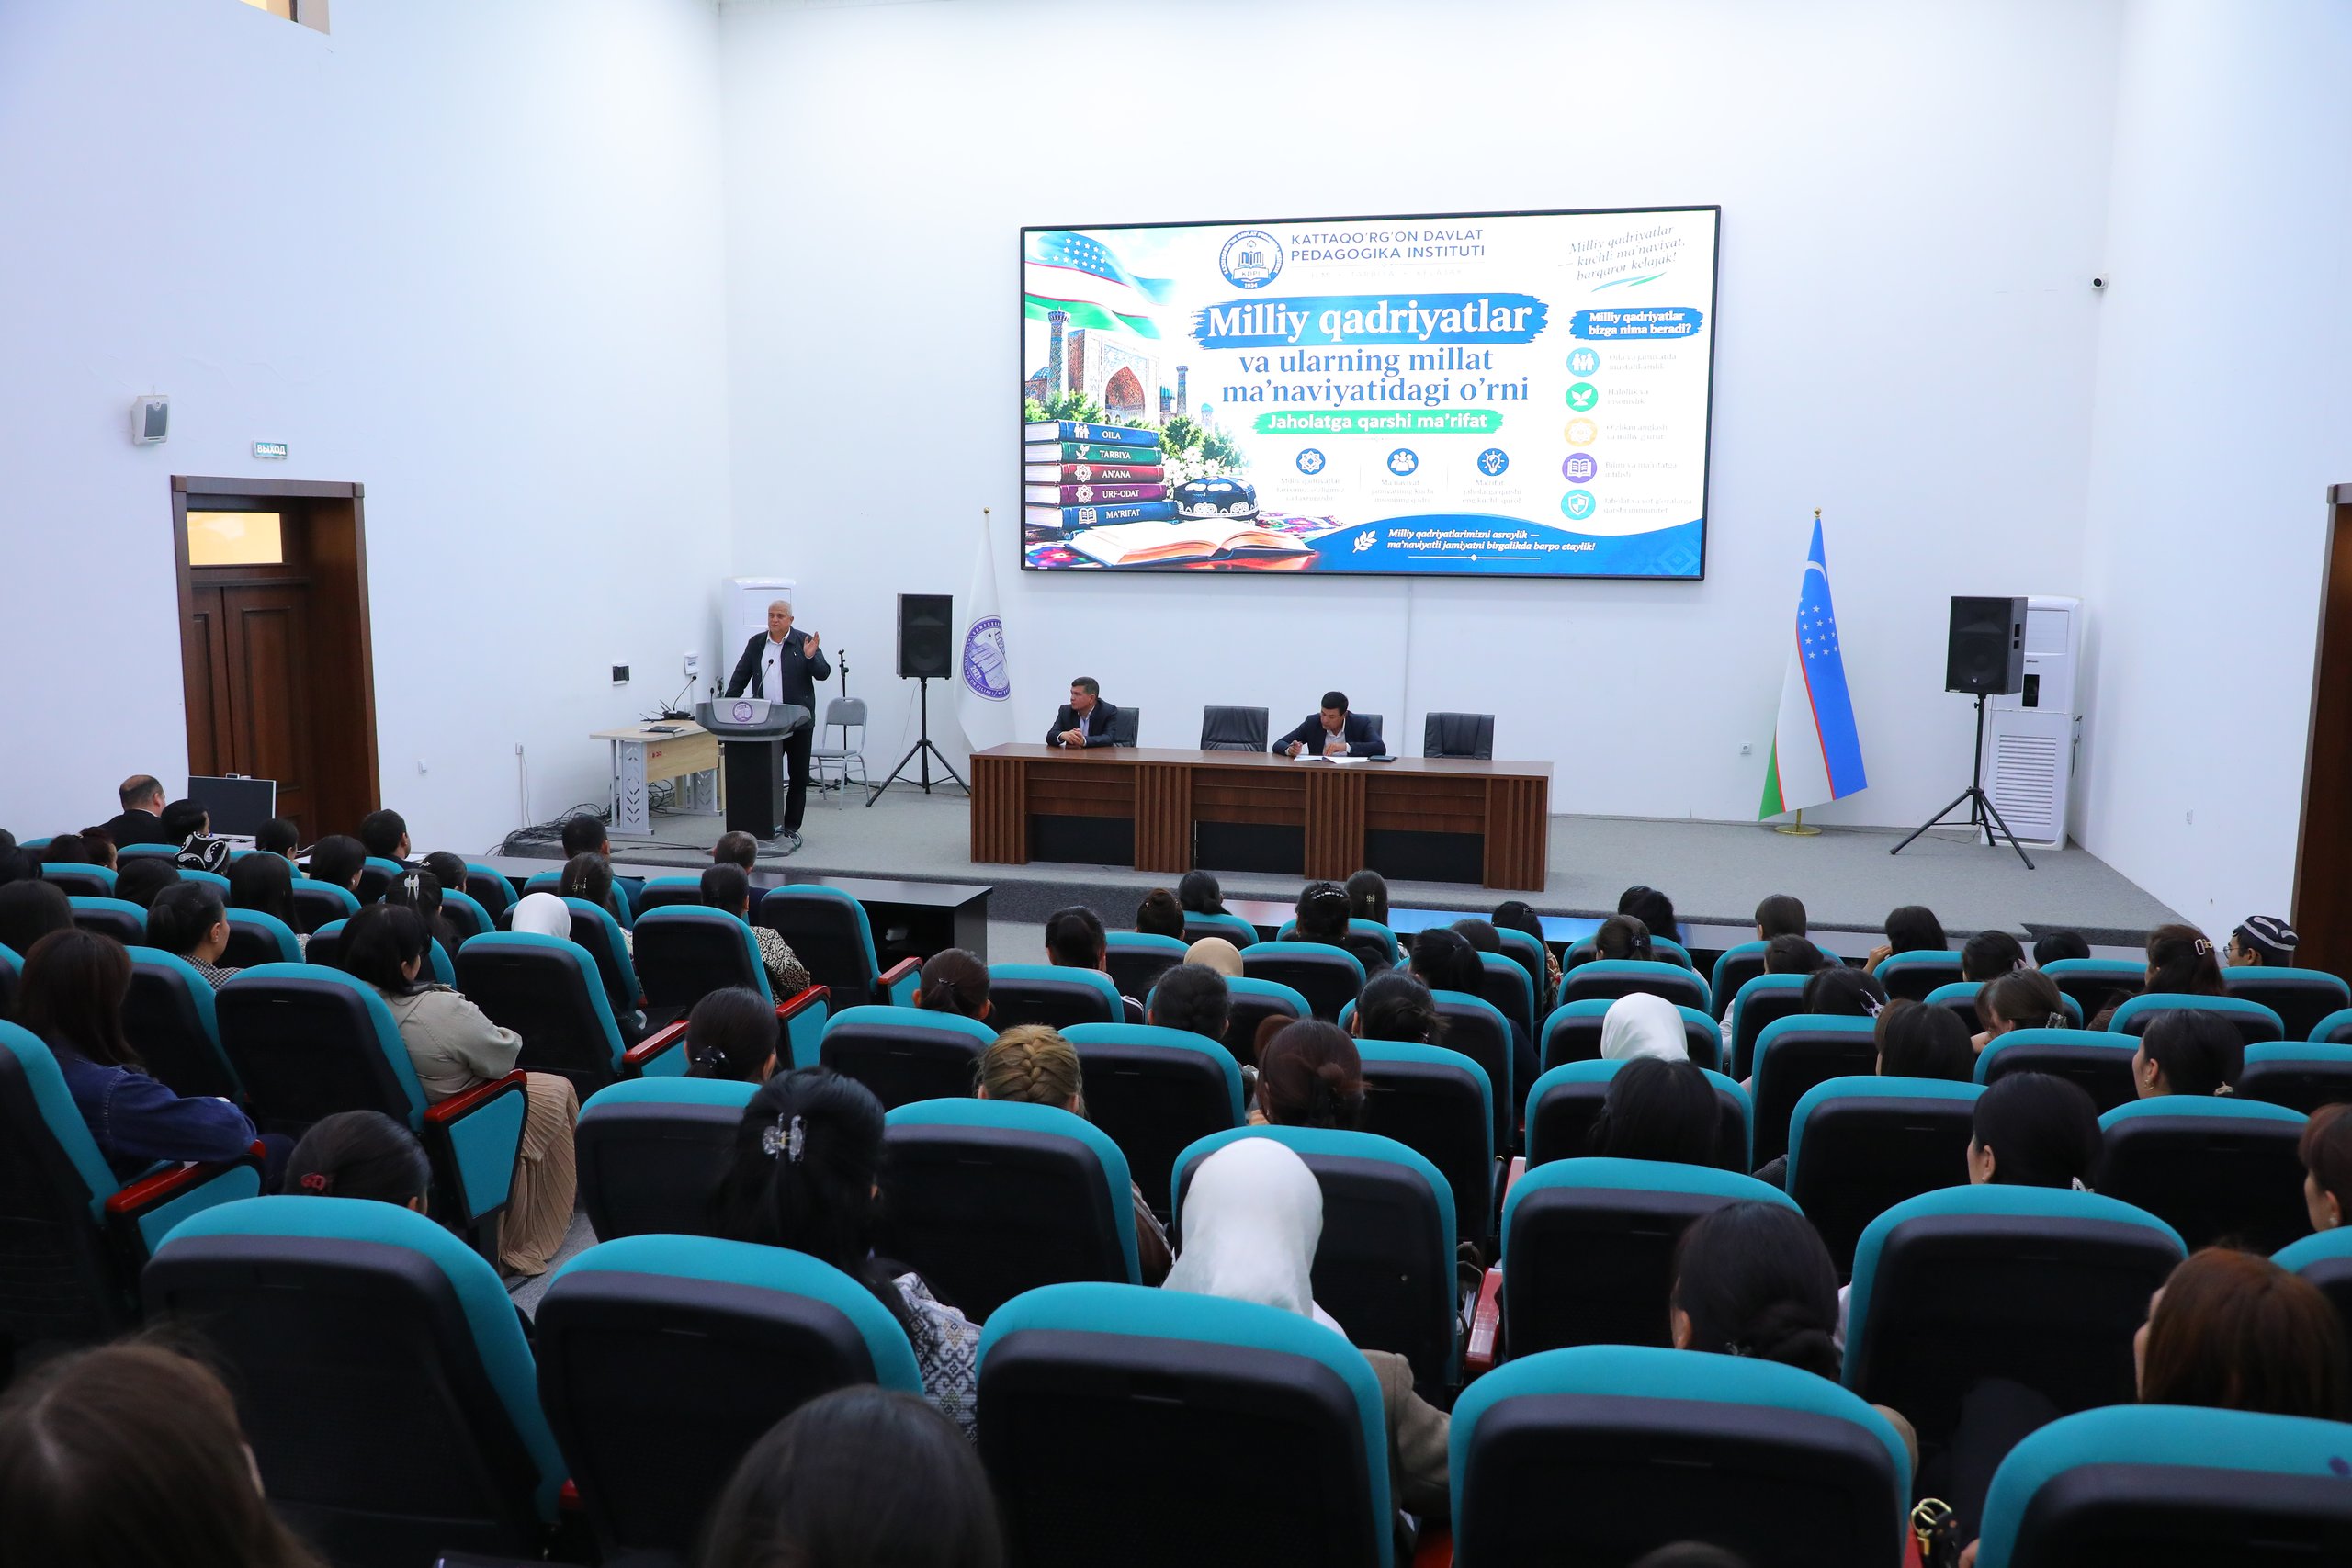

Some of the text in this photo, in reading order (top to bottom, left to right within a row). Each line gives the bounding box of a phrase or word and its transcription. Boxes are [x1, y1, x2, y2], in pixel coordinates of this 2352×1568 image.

[1424, 229, 1484, 242] DAVLAT
[1291, 244, 1485, 262] PEDAGOGIKA INSTITUTI
[1577, 251, 1613, 266] kuchli
[1631, 252, 1677, 270] kelajak!
[1208, 298, 1533, 343] Milliy qadriyatlar
[1589, 310, 1686, 323] Milliy qadriyatlar
[1589, 323, 1691, 336] bizga nima beradi?
[1238, 346, 1494, 378] va ularning millat
[1222, 376, 1529, 407] ma'naviyatidagi o'rni
[1267, 412, 1488, 433] Jaholatga qarshi ma'rifat
[1102, 431, 1121, 439] OILA
[257, 444, 287, 456] ВЫХОД
[1100, 450, 1131, 459] TARBIYA
[1102, 470, 1131, 479] AN'ANA
[1102, 490, 1139, 498] URF-ODAT
[1106, 509, 1140, 519] MA'RIFAT
[1387, 528, 1415, 540] Milliy
[1415, 528, 1491, 540] qadriyatlarimizni
[1492, 529, 1527, 541] asraylik
[1386, 540, 1597, 553] ma'naviyatli jamiyatni birgalikda barpo etaylik!
[970, 665, 982, 680] 2021
[976, 685, 995, 695] FILIALI
